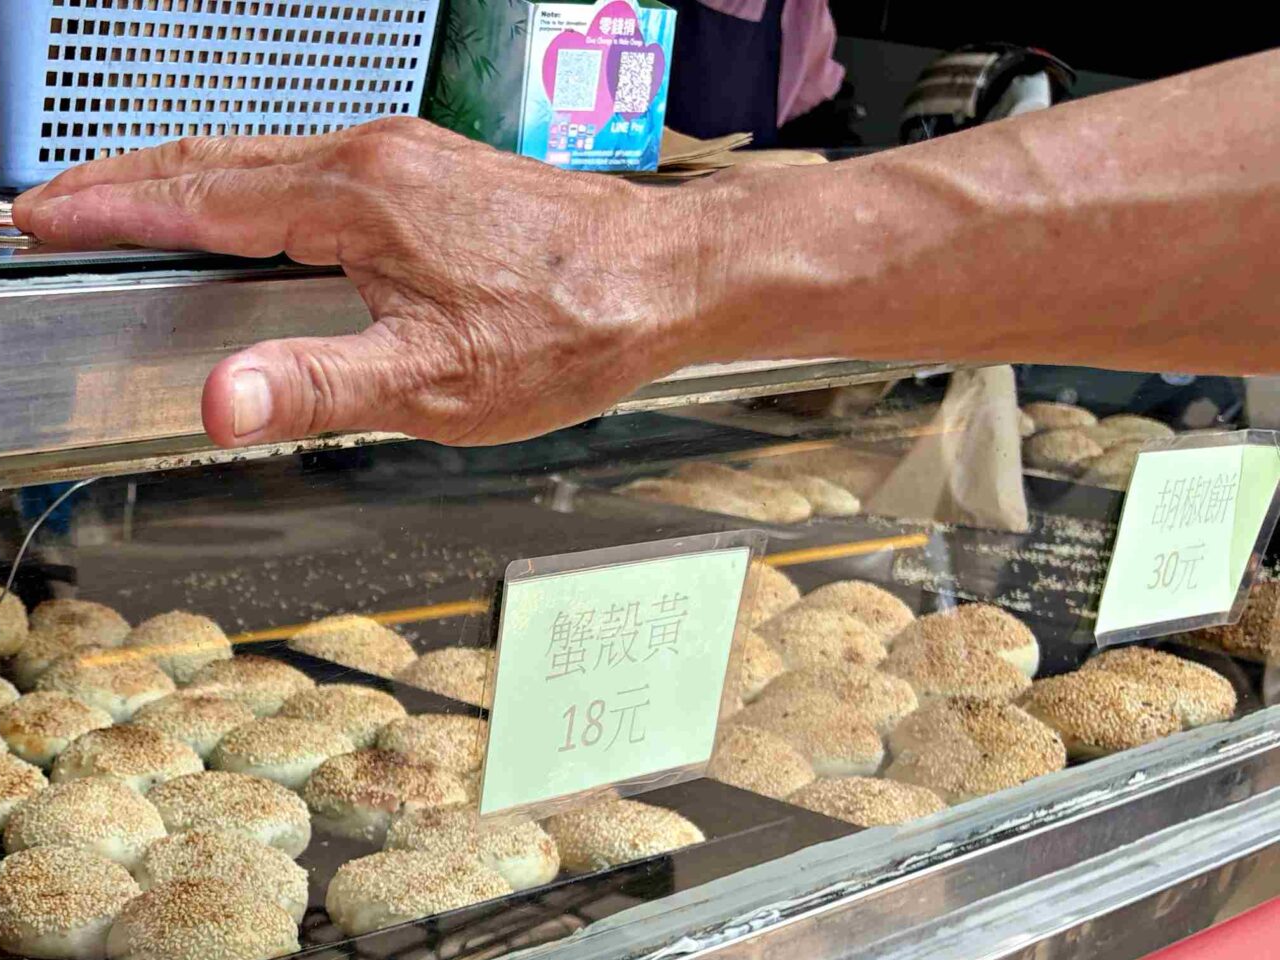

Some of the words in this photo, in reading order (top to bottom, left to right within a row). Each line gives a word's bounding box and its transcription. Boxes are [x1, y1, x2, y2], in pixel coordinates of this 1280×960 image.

[1152, 474, 1237, 530] 胡椒餅
[1147, 540, 1205, 594] 30元
[544, 592, 688, 682] 蟹殼黃
[557, 684, 650, 753] 18元
